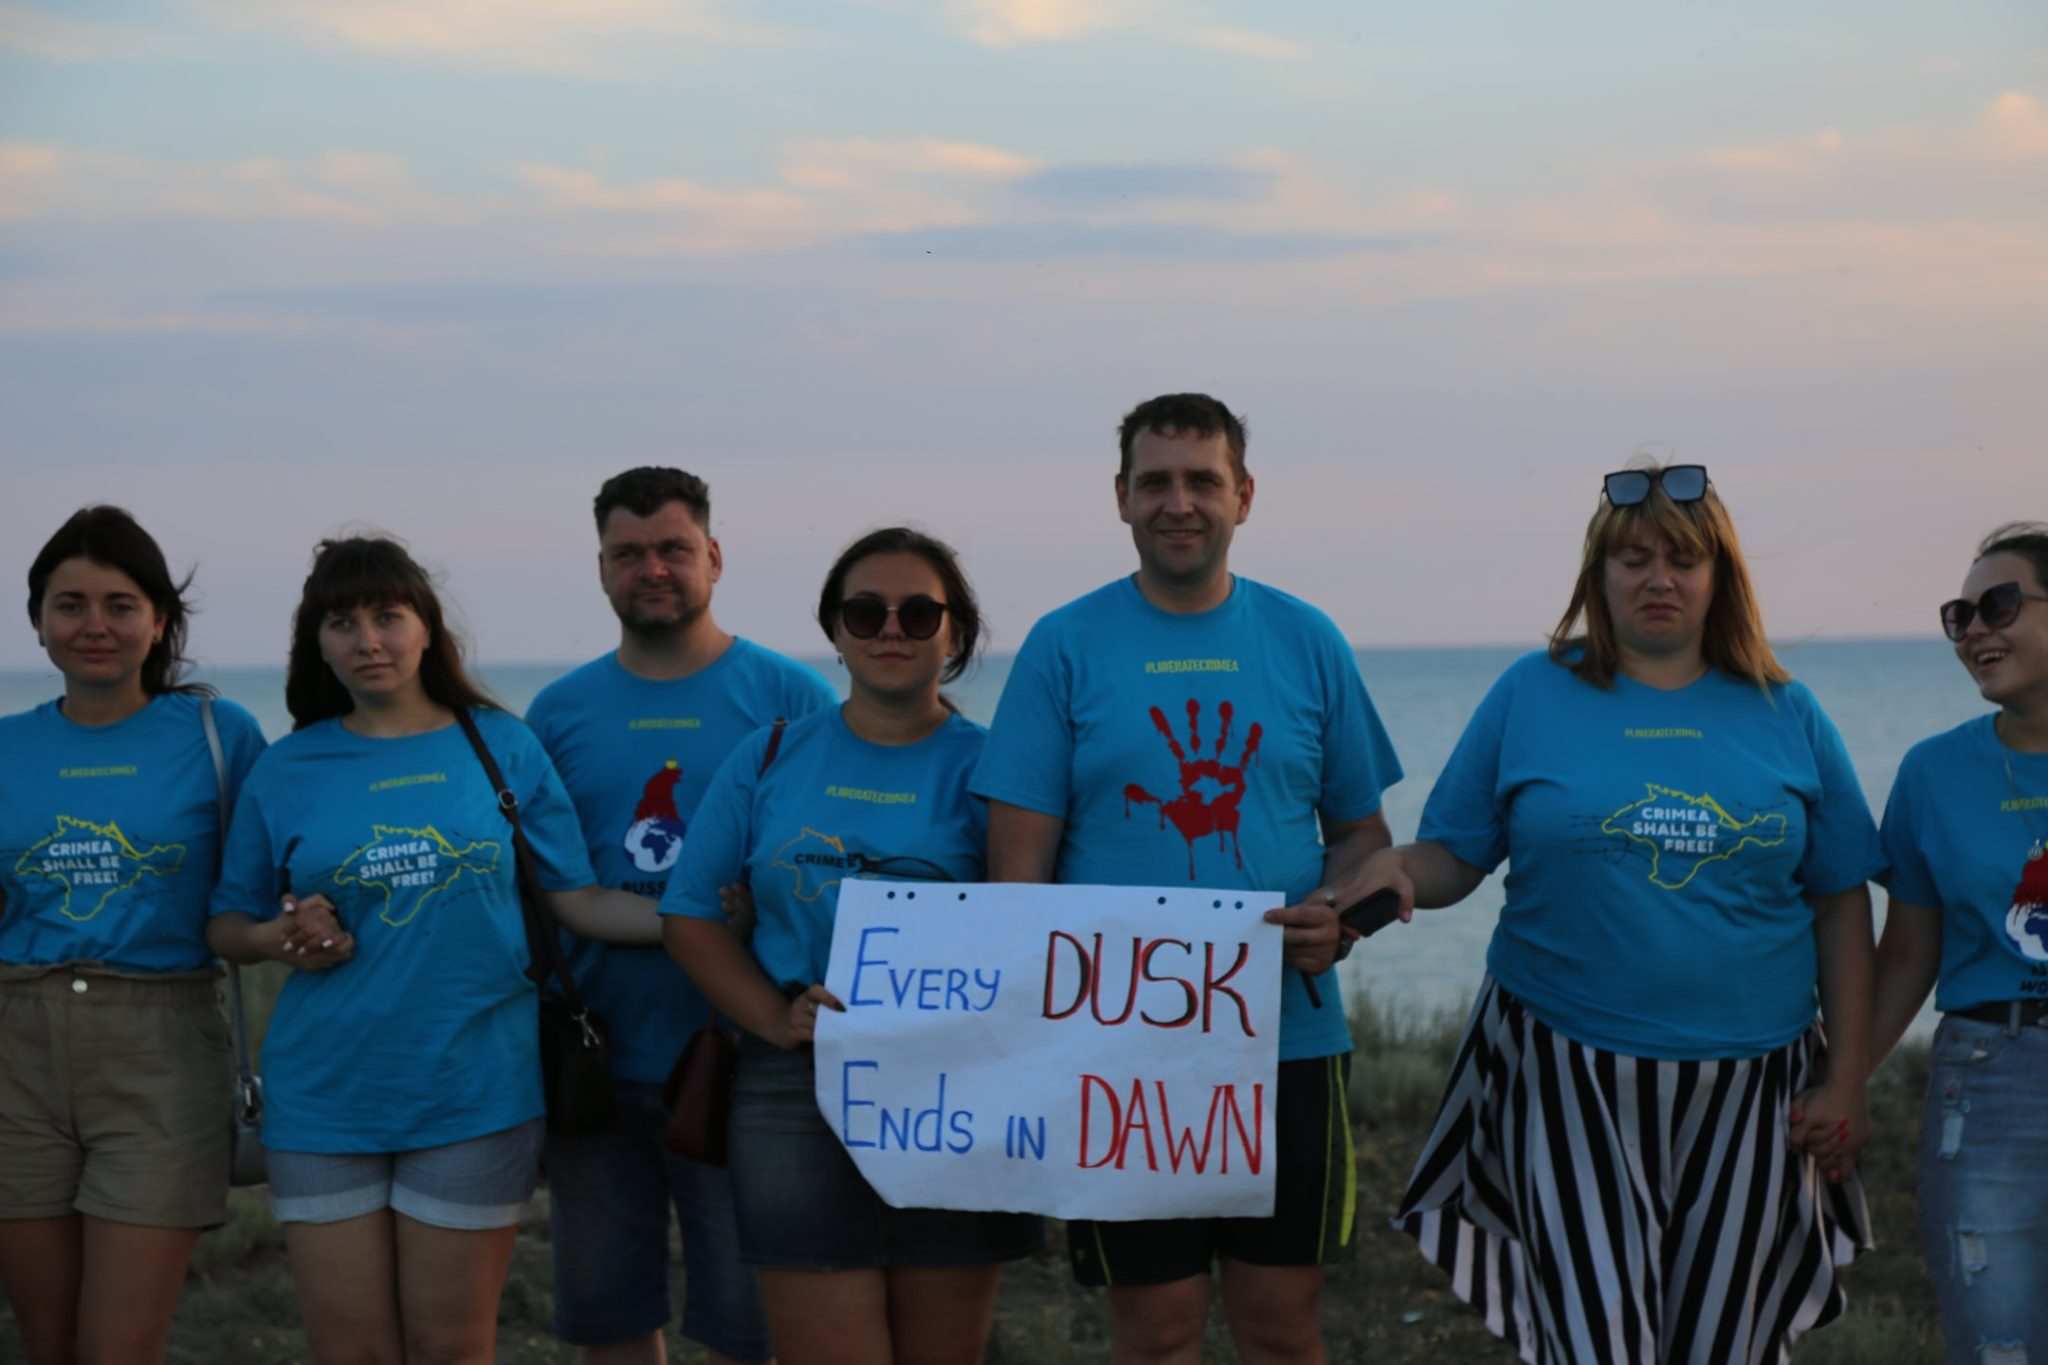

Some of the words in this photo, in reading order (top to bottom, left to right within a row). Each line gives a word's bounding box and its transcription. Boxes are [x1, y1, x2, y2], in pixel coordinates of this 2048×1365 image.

[1641, 807, 1711, 821] CRIMEA
[1632, 821, 1691, 836] SHALL
[1695, 824, 1718, 837] BE
[48, 840, 113, 857] CRIMEA
[365, 840, 432, 862] CRIMEA
[1664, 839, 1714, 853] FREE!
[42, 856, 95, 872] SHALL
[100, 856, 121, 869] BE
[359, 859, 414, 880] SHALL
[417, 853, 438, 869] BE
[794, 852, 857, 869] CRIME
[73, 870, 119, 885] FREE!
[391, 870, 436, 889] FREE!
[1041, 930, 1257, 1038] DUSK
[1005, 1114, 1047, 1161] IN
[1076, 1073, 1264, 1176] DAWN
